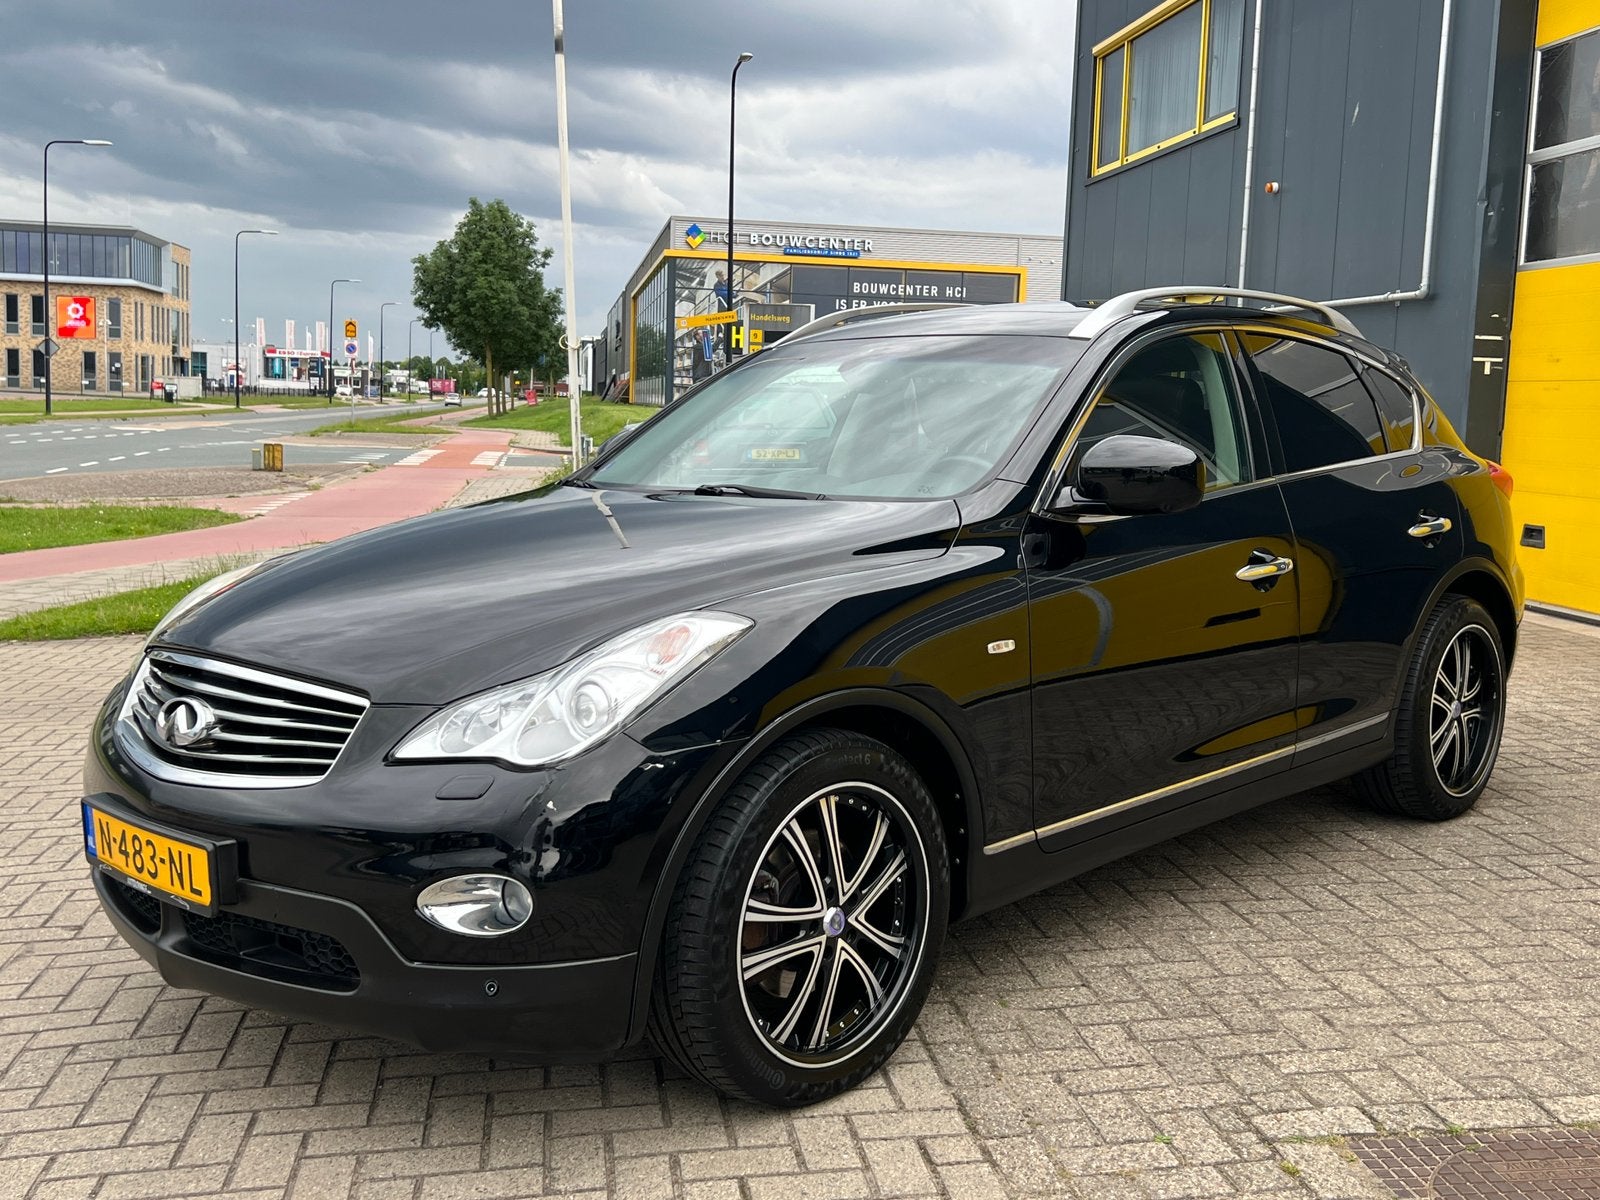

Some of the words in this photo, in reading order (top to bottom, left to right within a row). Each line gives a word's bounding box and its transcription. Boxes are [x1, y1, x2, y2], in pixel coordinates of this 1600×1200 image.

[750, 232, 873, 252] BOUWCENTER
[853, 282, 938, 297] BOUWCENTER
[945, 286, 967, 298] HCI
[835, 299, 848, 310] IS
[852, 300, 867, 309] ER
[750, 314, 791, 323] Handelsweg
[99, 818, 203, 897] N-483-NL
